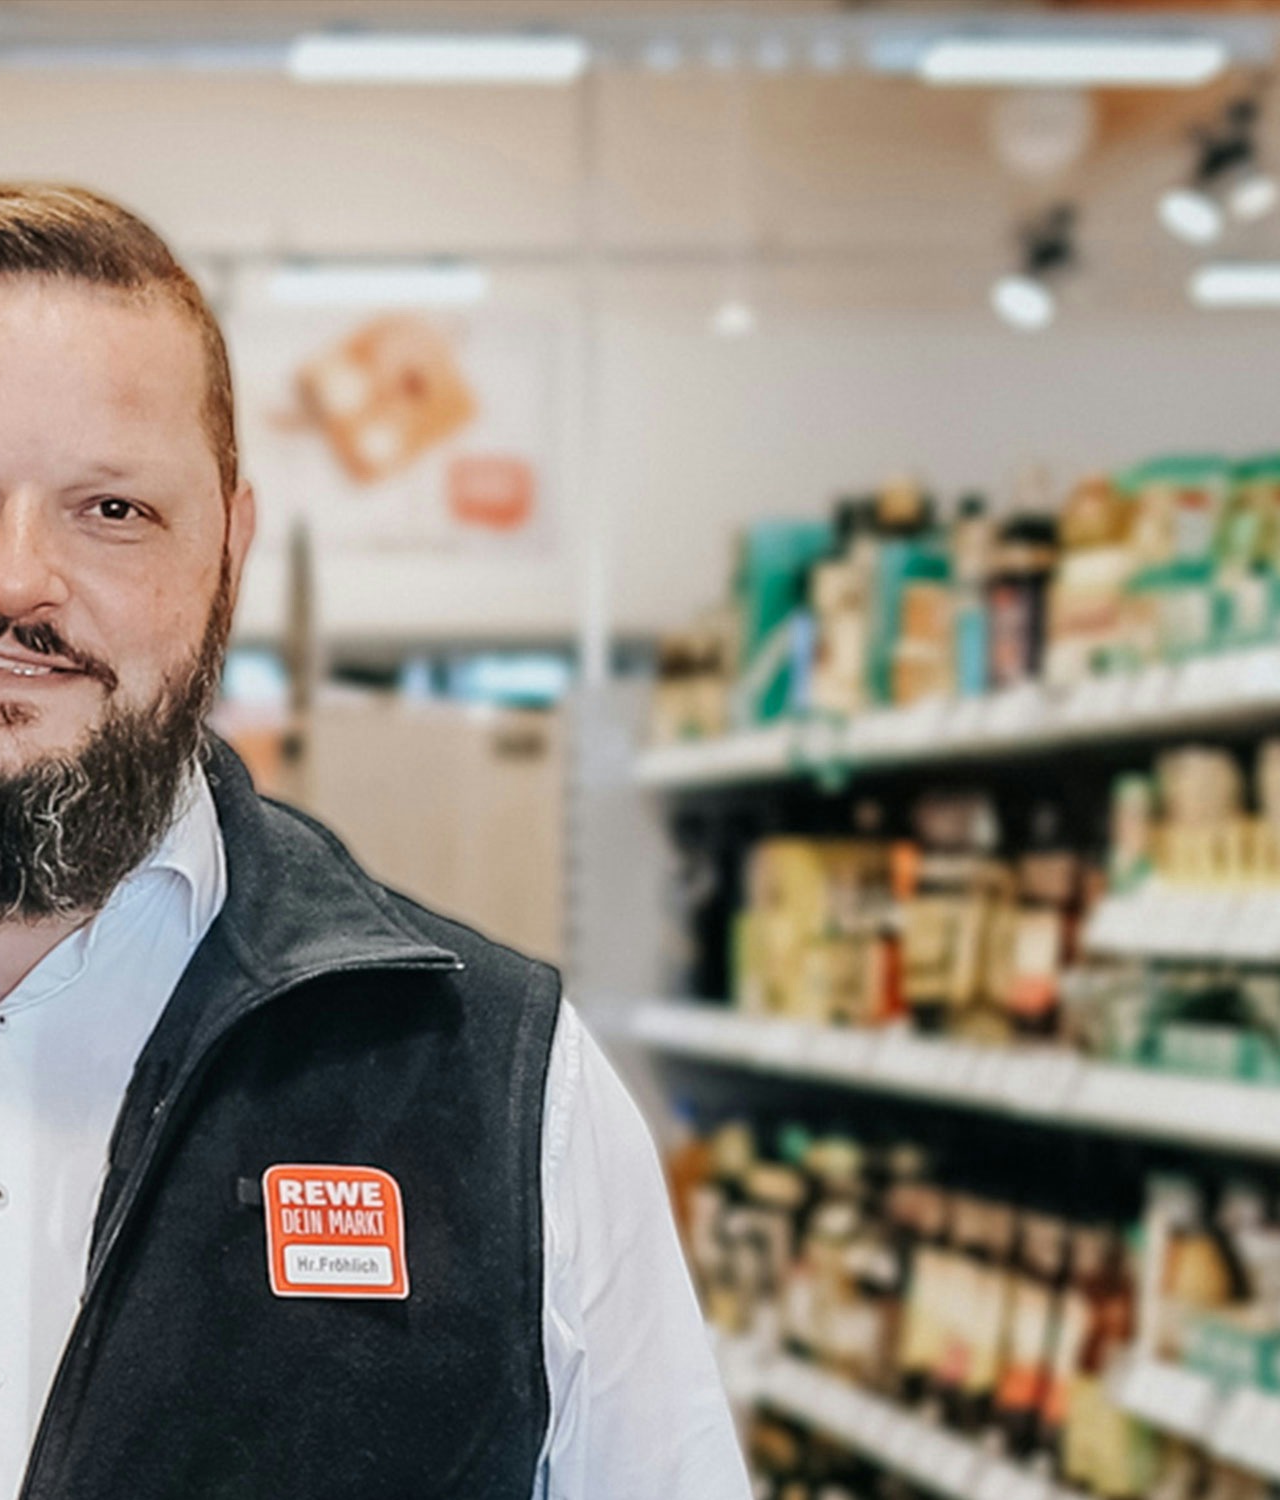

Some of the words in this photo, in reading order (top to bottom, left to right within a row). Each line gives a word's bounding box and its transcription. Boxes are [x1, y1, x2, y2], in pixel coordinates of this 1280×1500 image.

[278, 1179, 384, 1207] REWE
[281, 1208, 323, 1235] DEIN
[328, 1209, 385, 1236] MARKT
